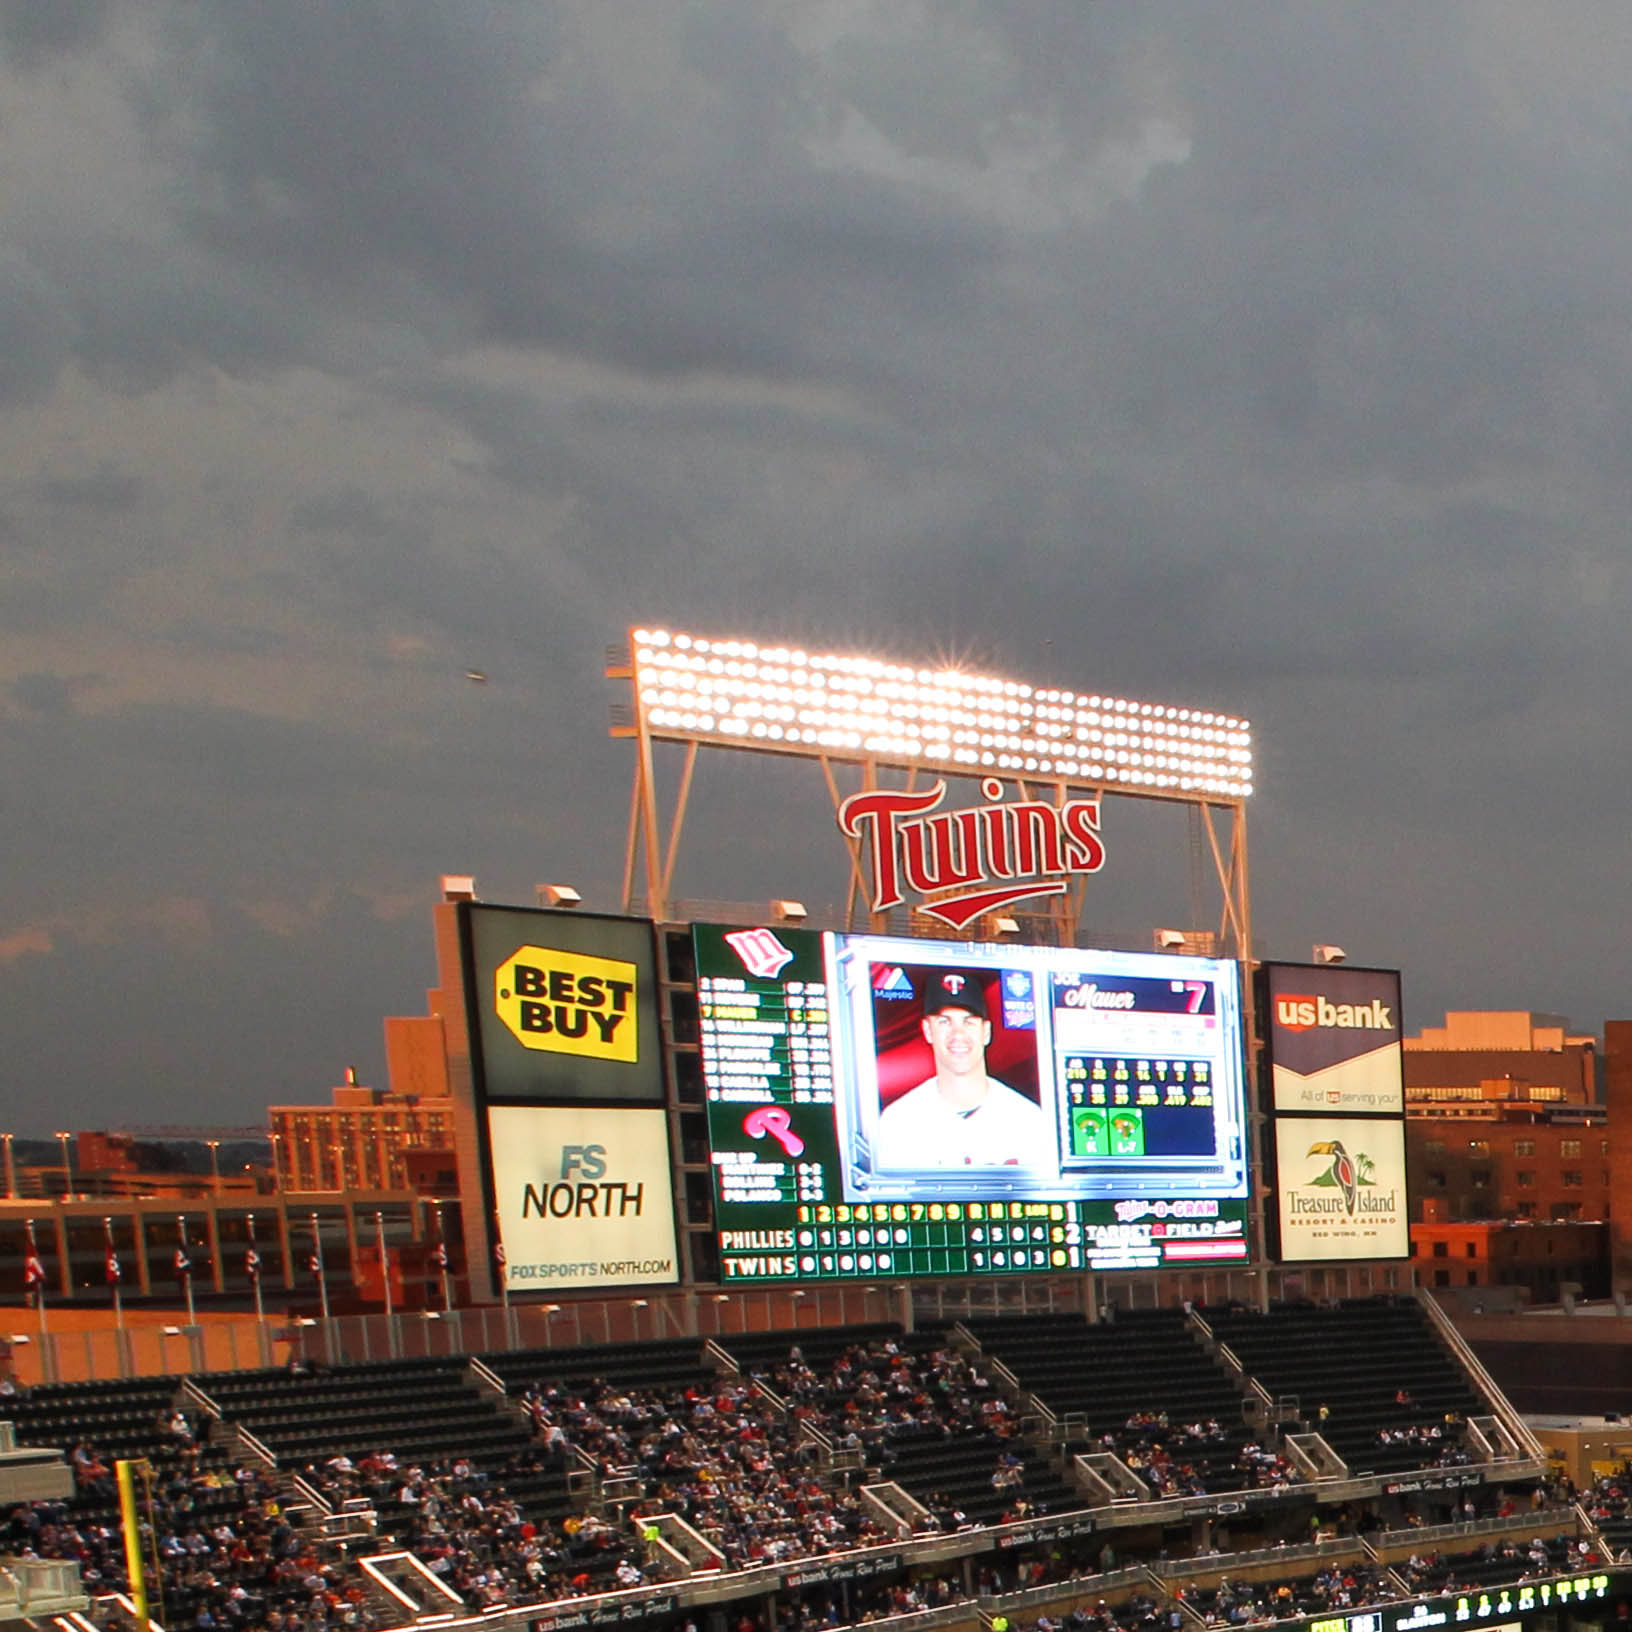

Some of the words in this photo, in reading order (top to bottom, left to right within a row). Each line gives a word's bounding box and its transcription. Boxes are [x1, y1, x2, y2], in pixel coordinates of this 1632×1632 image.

[838, 778, 1105, 929] Twins
[514, 964, 633, 1012] BEST
[874, 989, 915, 1001] Majestic
[1064, 984, 1136, 1011] Mauer
[1184, 980, 1208, 1014] 7
[519, 1000, 624, 1043] BUY
[1277, 996, 1395, 1030] usbank
[1301, 1090, 1313, 1101] All
[1314, 1090, 1325, 1101] of
[1341, 1091, 1376, 1105] serving
[560, 1145, 606, 1179] FS
[522, 1183, 643, 1219] NORTH
[799, 1206, 809, 1222] 1
[816, 1206, 831, 1222] 2
[836, 1206, 850, 1222] 3
[855, 1206, 869, 1221] 4
[874, 1206, 889, 1221] 5
[892, 1205, 907, 1220] 6
[911, 1205, 925, 1220] 7
[929, 1205, 943, 1220] 8
[946, 1204, 962, 1220] 9
[968, 1204, 984, 1219] R
[990, 1204, 1004, 1219] H
[1009, 1203, 1023, 1219] E
[1066, 1202, 1076, 1222] 1
[1287, 1190, 1344, 1214] Treasure
[1357, 1190, 1396, 1214] Island
[1086, 1224, 1152, 1241] TARGET
[1166, 1223, 1213, 1237] FIELD
[1290, 1218, 1336, 1226] RESORT
[1340, 1217, 1348, 1226] &
[1353, 1217, 1397, 1226] CASINO
[720, 1230, 795, 1250] PHILLIES
[800, 1231, 813, 1246] 0
[821, 1231, 831, 1245] 1
[839, 1230, 851, 1245] 3
[858, 1230, 871, 1245] 0
[877, 1229, 890, 1244] 0
[894, 1229, 907, 1244] 0
[971, 1227, 984, 1242] 4
[990, 1227, 1003, 1241] 5
[1031, 1226, 1045, 1241] 4
[1066, 1223, 1081, 1244] 2
[722, 1256, 796, 1277] TWINS
[802, 1256, 815, 1272] 0
[823, 1256, 833, 1271] 1
[858, 1255, 872, 1270] 0
[877, 1255, 891, 1270] 0
[974, 1252, 985, 1267] 1
[992, 1252, 1006, 1267] 4
[1033, 1250, 1046, 1265] 3
[1069, 1246, 1080, 1267] 1
